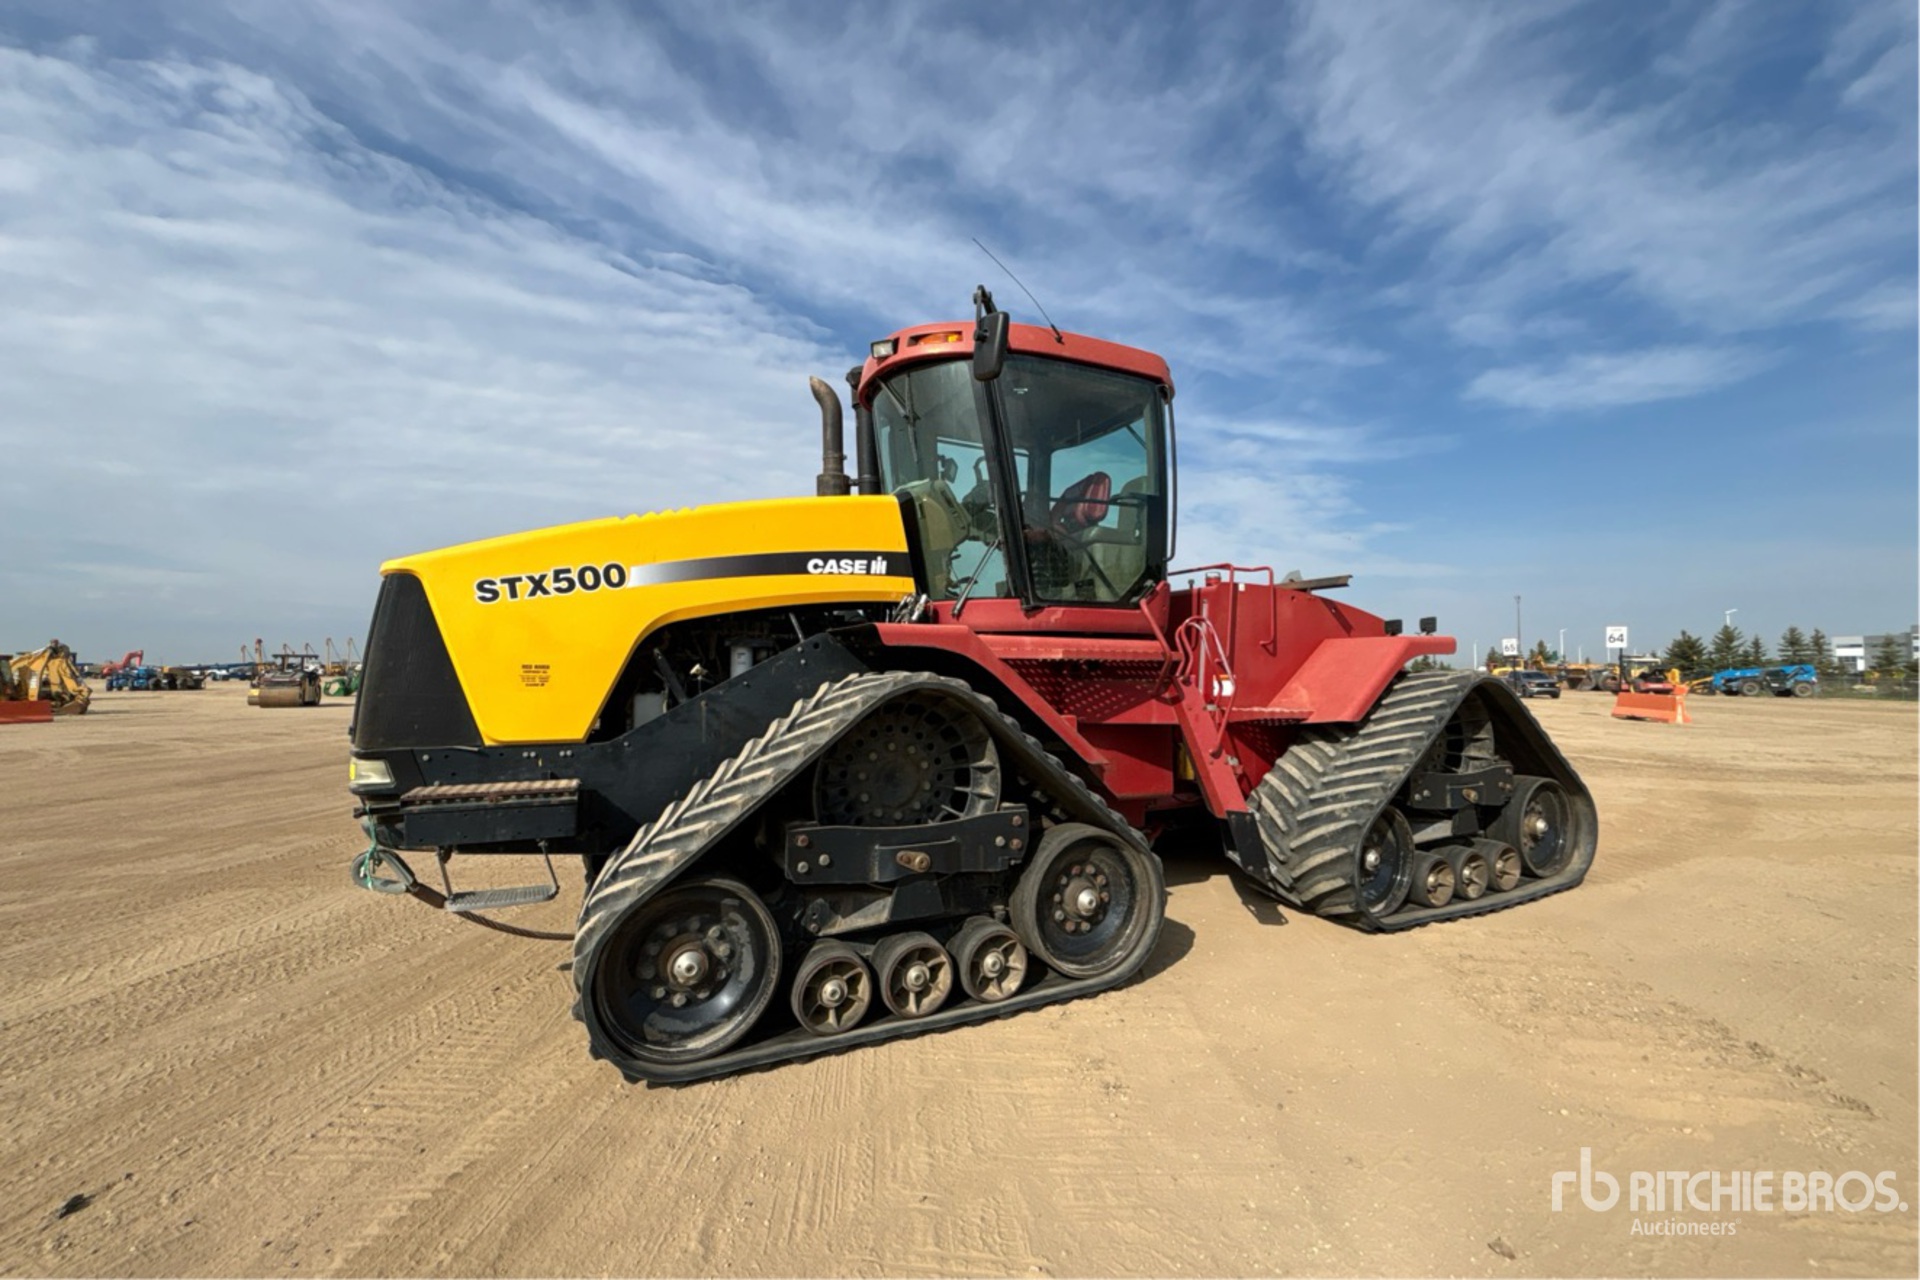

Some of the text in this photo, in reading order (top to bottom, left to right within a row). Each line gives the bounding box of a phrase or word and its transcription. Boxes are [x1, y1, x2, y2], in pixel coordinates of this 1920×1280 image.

[807, 558, 868, 575] CASE
[475, 562, 627, 603] STX500
[1608, 633, 1624, 644] 64
[1504, 643, 1516, 652] 65
